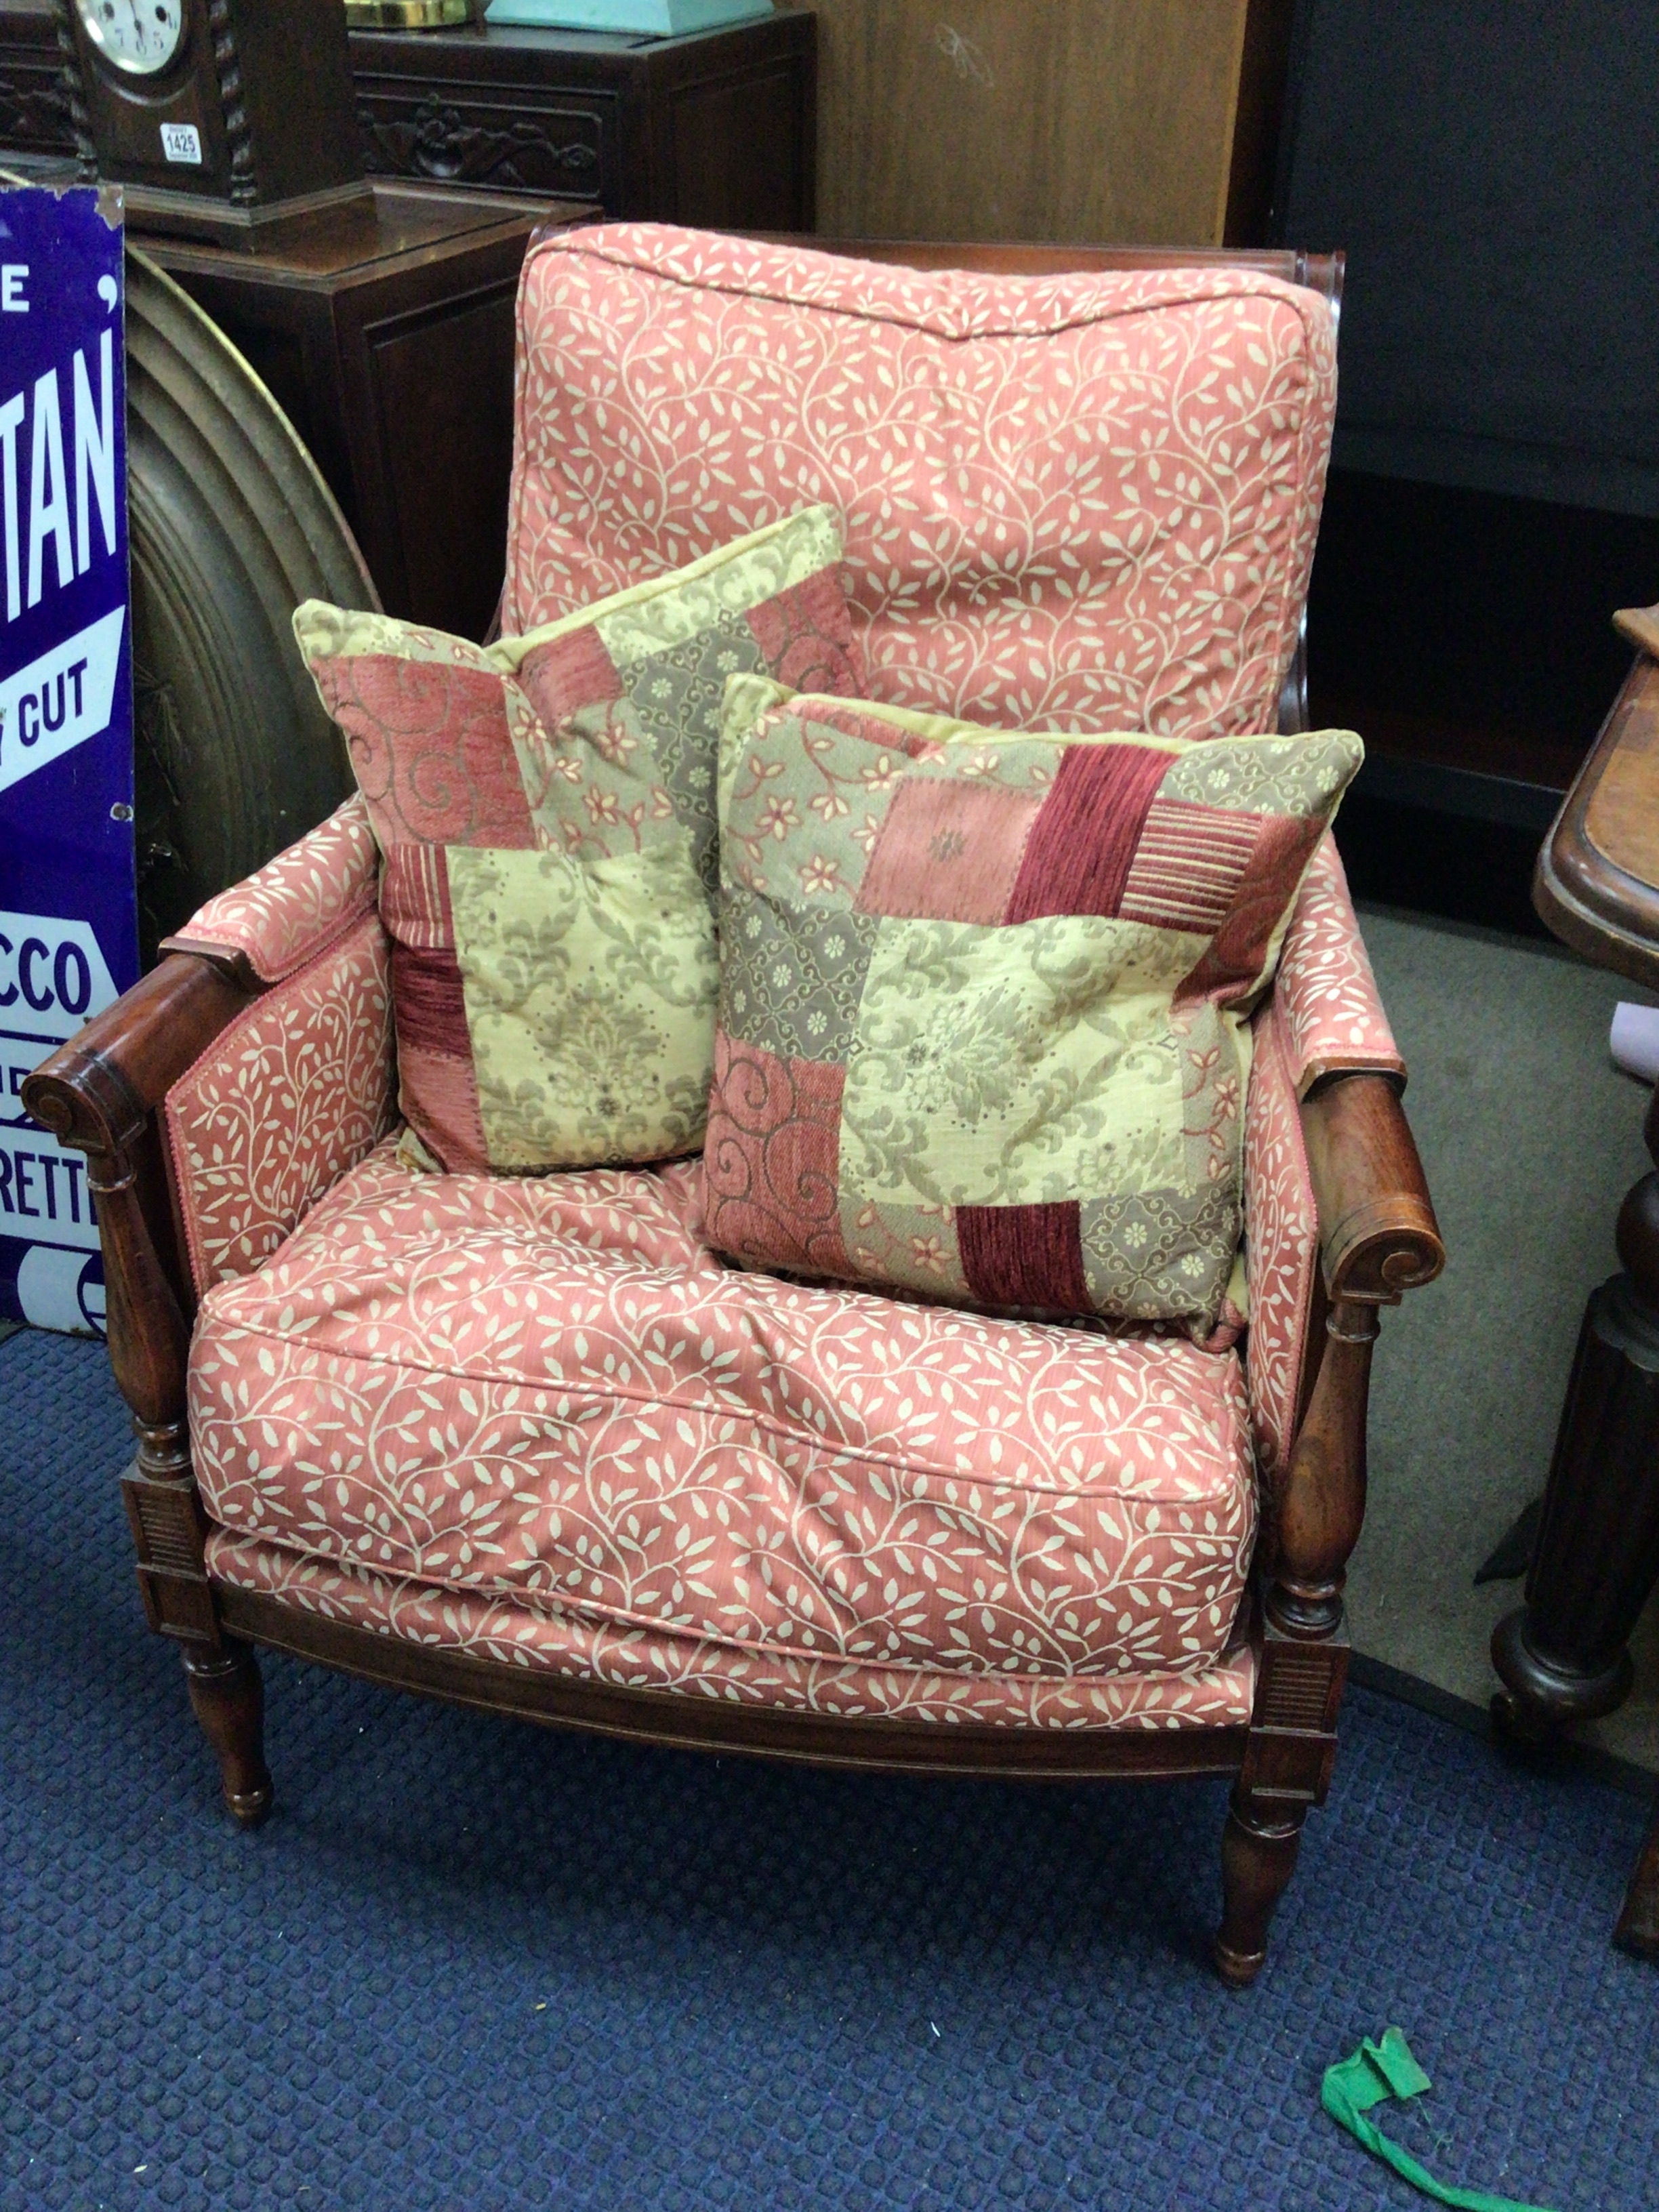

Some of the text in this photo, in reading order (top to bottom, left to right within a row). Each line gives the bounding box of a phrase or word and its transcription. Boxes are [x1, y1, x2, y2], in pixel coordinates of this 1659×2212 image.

[115, 27, 124, 47] 7
[167, 133, 196, 153] 1425
[18, 657, 87, 747] CUT
